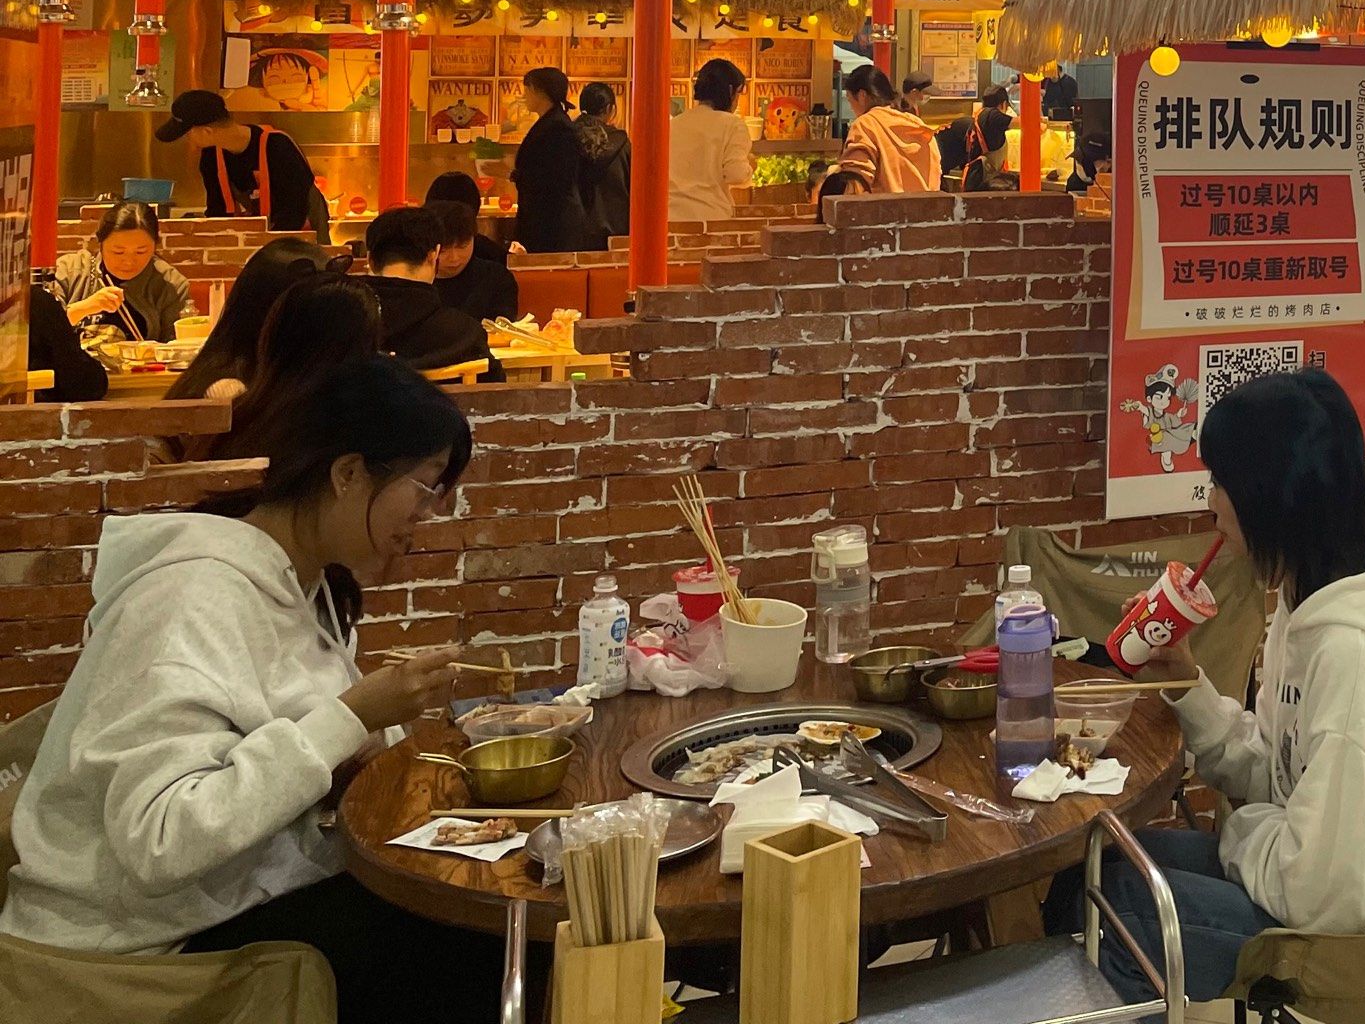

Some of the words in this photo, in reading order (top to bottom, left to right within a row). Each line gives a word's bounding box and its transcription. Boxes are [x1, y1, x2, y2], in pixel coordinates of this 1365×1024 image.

[430, 81, 492, 96] WANTED
[756, 83, 810, 96] WANTED
[1137, 80, 1150, 133] QUEUING
[1153, 96, 1352, 151] 排队规则
[1137, 135, 1152, 198] DISCIPLINE
[1179, 182, 1319, 207] 过号10桌以内
[1208, 212, 1291, 236] 顺延3桌
[1172, 255, 1349, 284] 过号10桌重新取号
[1195, 303, 1332, 321] 破破烂烂的烤肉店
[1130, 550, 1158, 565] JIN
